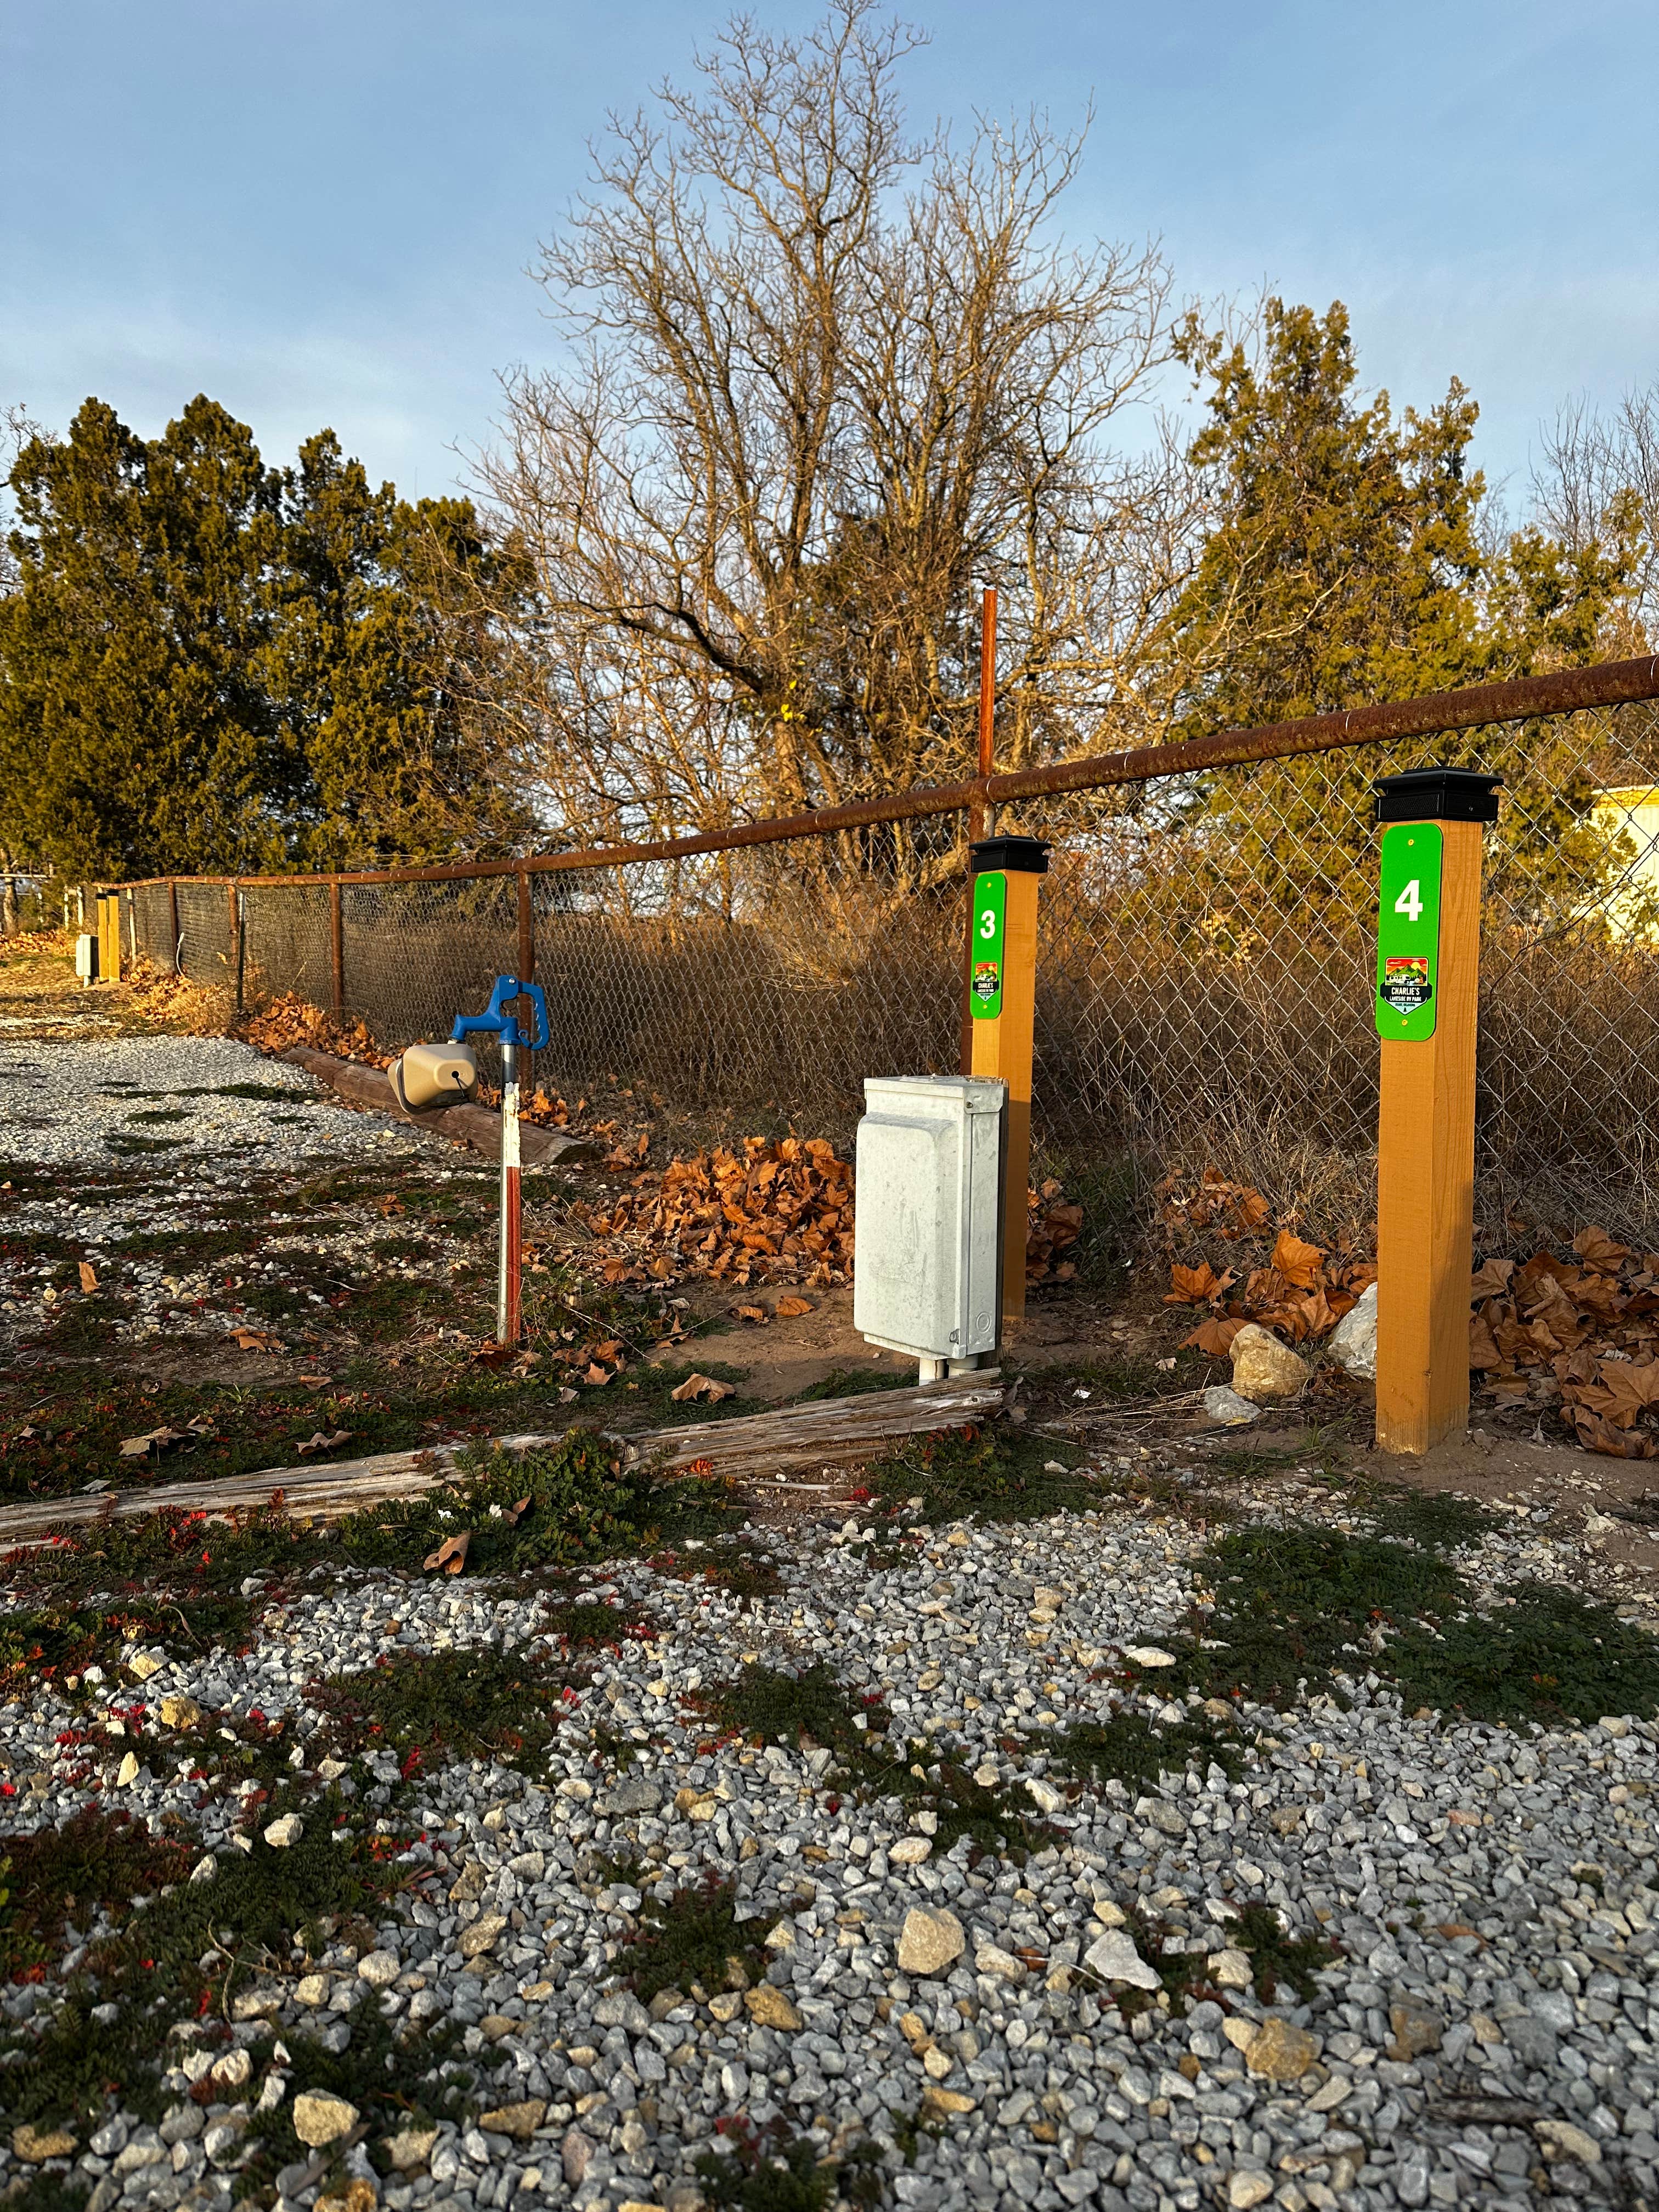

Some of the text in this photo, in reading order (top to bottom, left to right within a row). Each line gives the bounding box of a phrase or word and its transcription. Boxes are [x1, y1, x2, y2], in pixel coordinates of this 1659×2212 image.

[1395, 879, 1423, 921] 4
[980, 910, 996, 939] 3
[1391, 987, 1420, 995] CHARLIE'S
